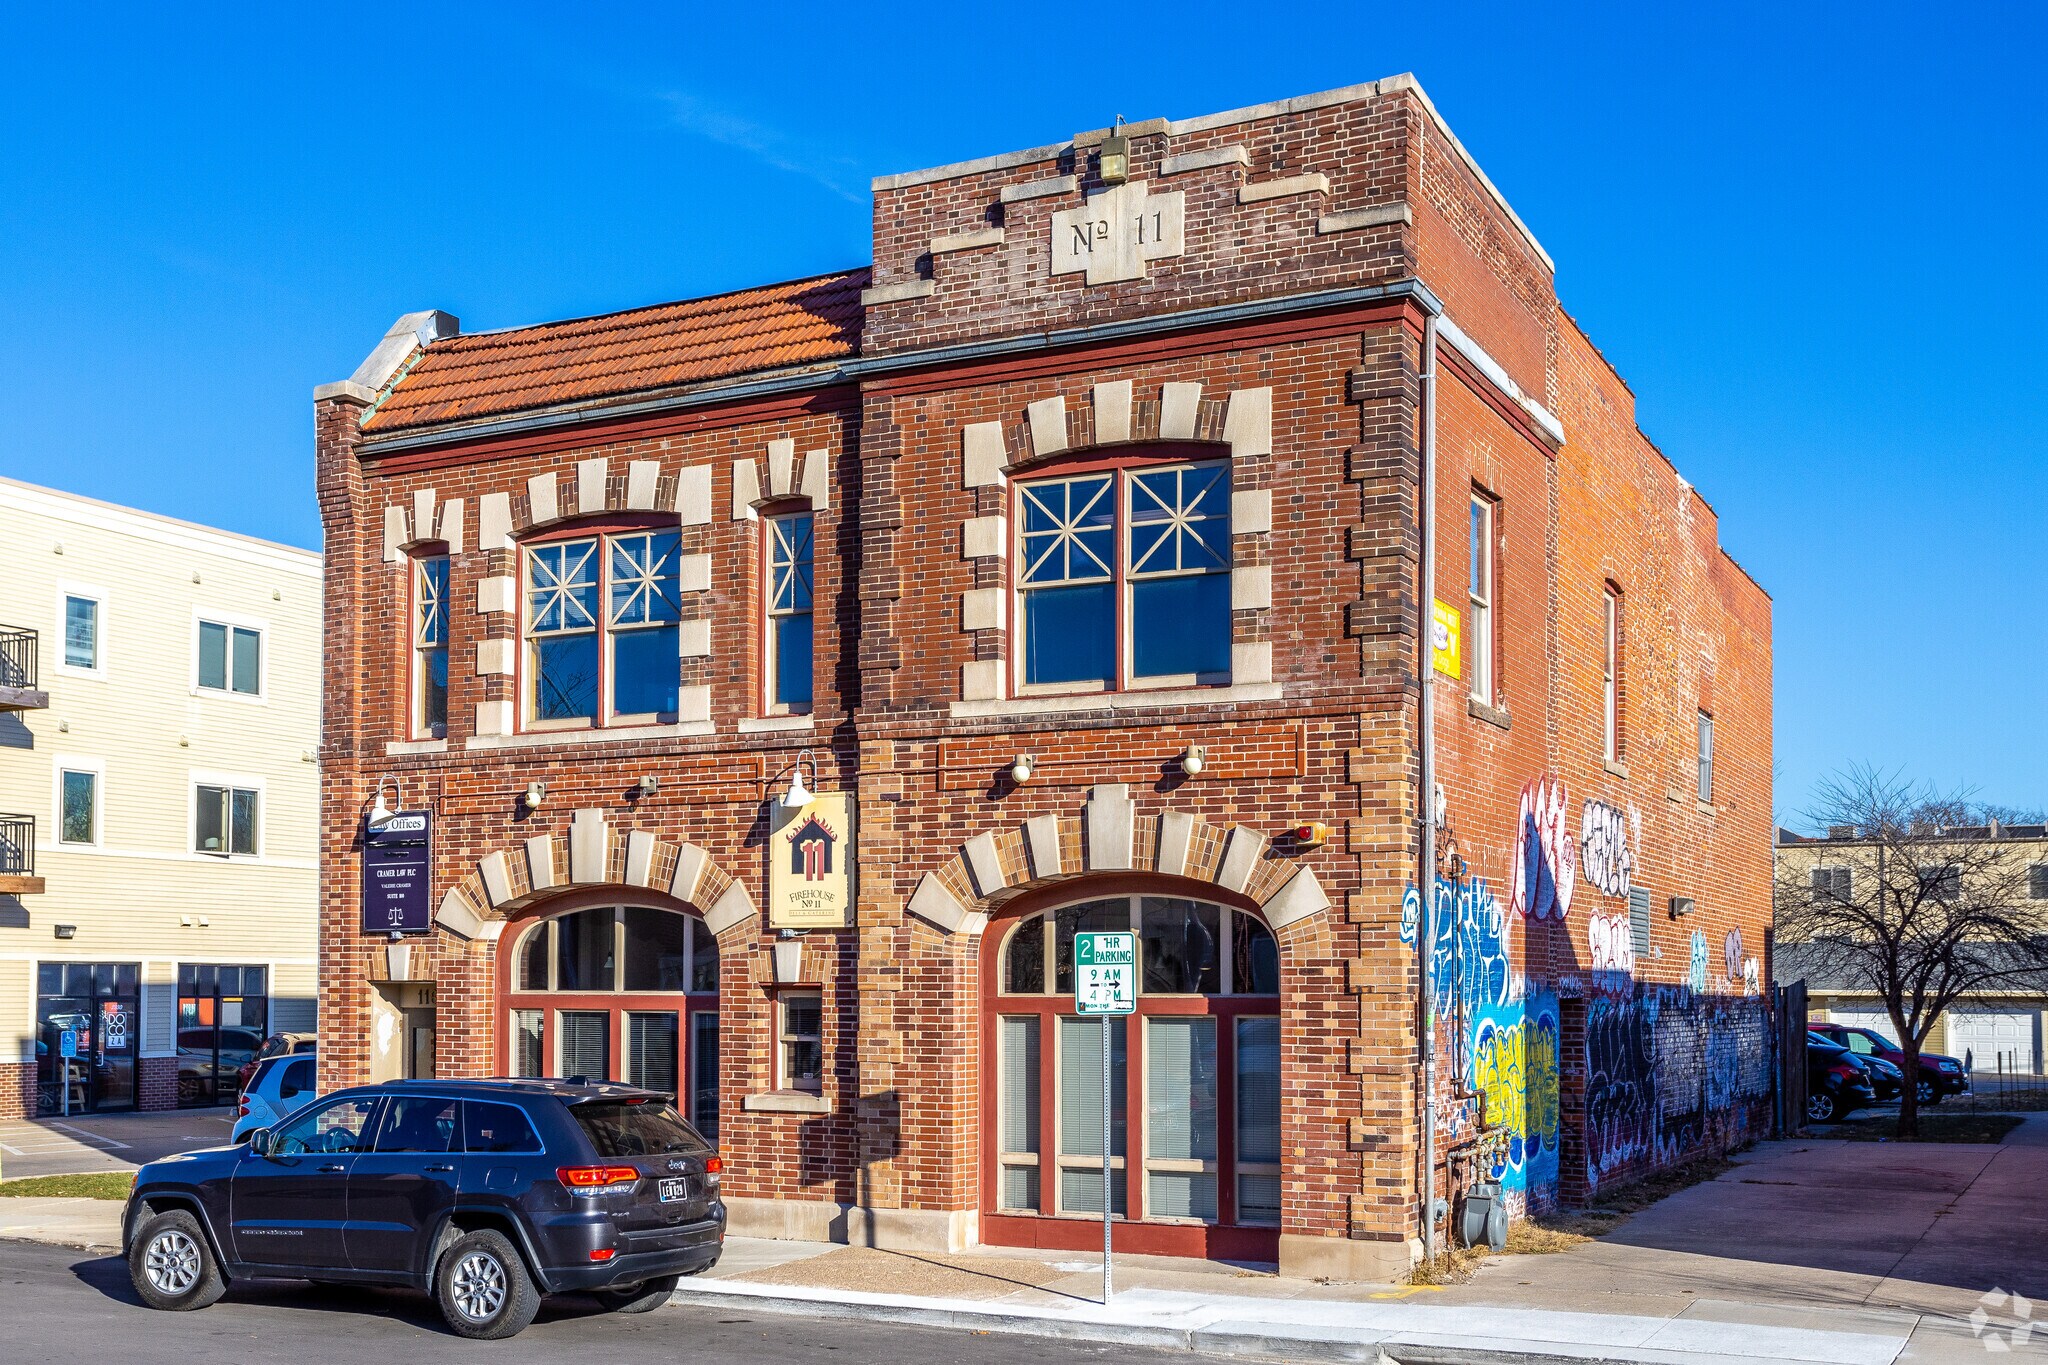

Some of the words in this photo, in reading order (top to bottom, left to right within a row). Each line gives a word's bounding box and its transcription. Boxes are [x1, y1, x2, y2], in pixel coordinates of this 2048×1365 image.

[1134, 210, 1163, 246] 11
[391, 818, 422, 830] Offices
[800, 838, 825, 882] 11
[397, 868, 407, 877] LAW
[407, 868, 417, 877] PLC
[789, 889, 836, 903] FIREHOUSE
[814, 900, 821, 908] 11
[1080, 939, 1091, 958] 2
[1105, 937, 1120, 949] HR
[1095, 951, 1131, 962] PARKING
[1091, 969, 1097, 980] 9
[1104, 969, 1121, 980] AM
[1090, 990, 1097, 1000] 4
[1105, 990, 1121, 1001] PM
[668, 1158, 686, 1171] Jeep
